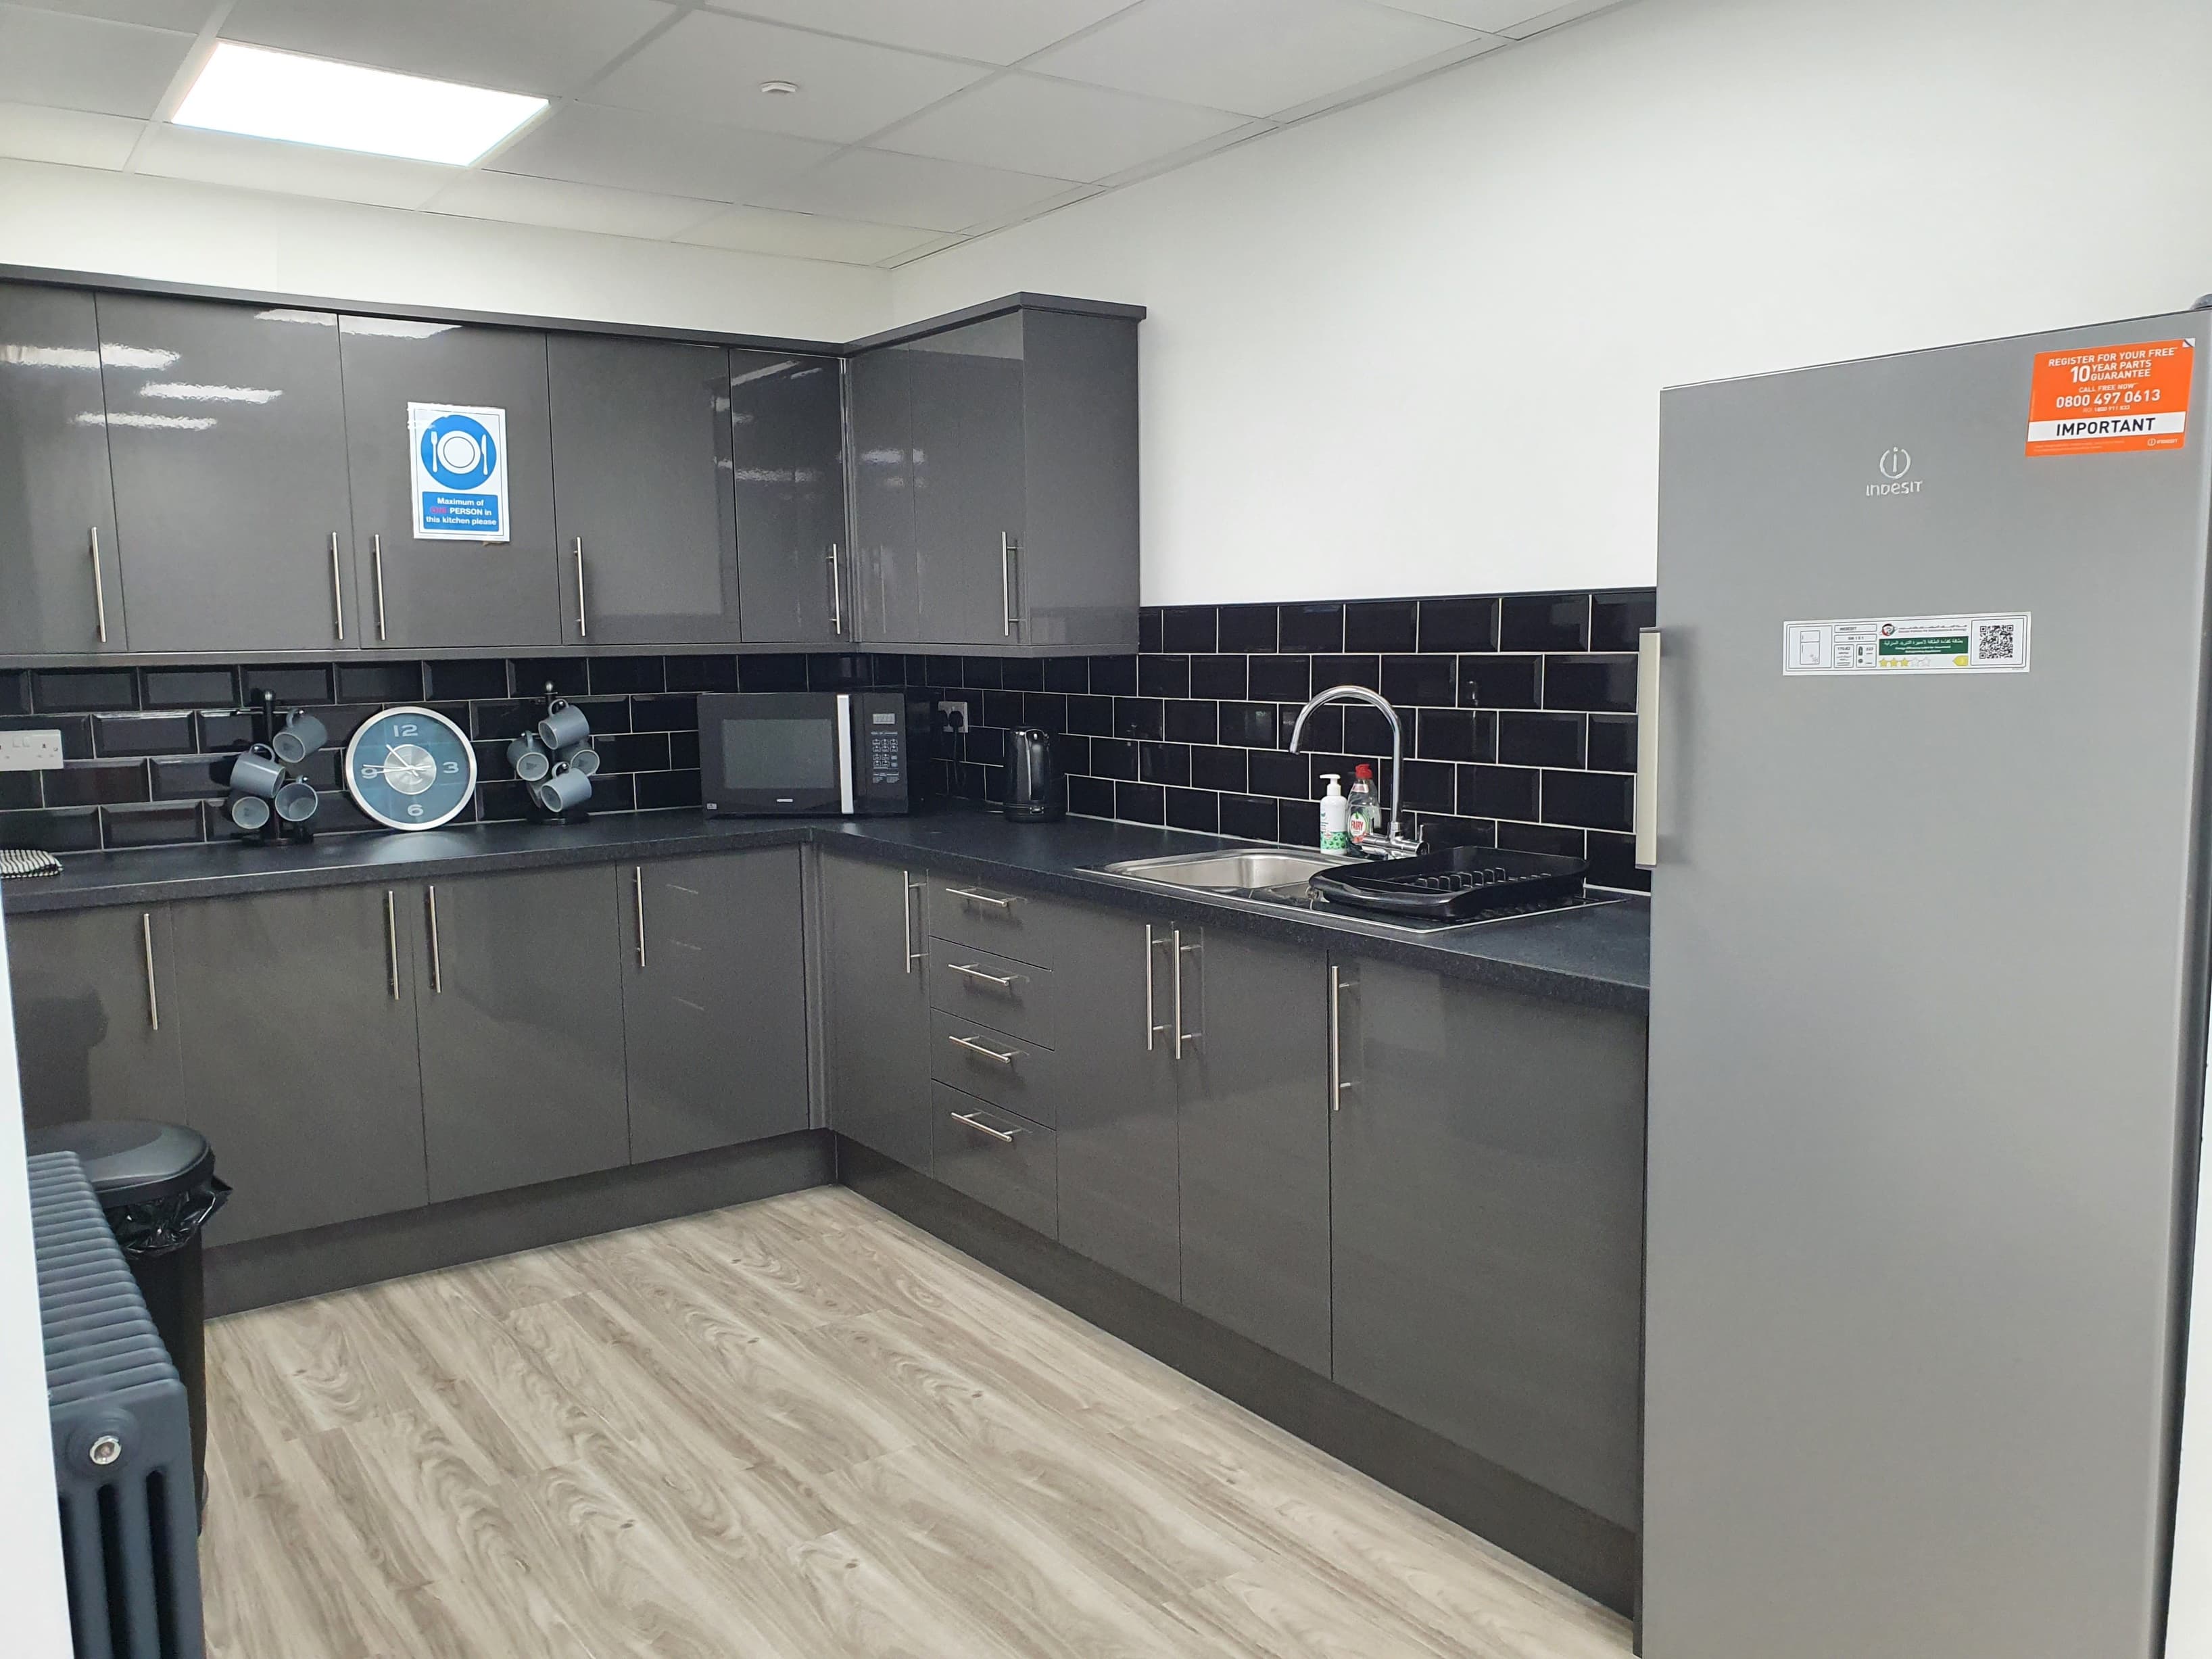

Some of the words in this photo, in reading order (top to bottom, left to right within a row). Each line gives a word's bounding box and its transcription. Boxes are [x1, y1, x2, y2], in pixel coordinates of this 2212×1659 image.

[2048, 355, 2095, 366] REGISTER
[2097, 353, 2117, 362] FOR
[2120, 350, 2146, 360] YOUR
[2092, 362, 2117, 372] YEAR
[2119, 360, 2152, 370] PARTS
[2070, 365, 2090, 383] 10
[2091, 368, 2152, 381] GUARANTEE
[2056, 394, 2090, 408] 0800
[2094, 391, 2121, 406] 497
[2124, 389, 2161, 404] 0613
[2057, 417, 2156, 437] IMPORTANT
[437, 497, 475, 506] Maximum
[450, 507, 483, 515] PERSON
[442, 516, 471, 524] kitchen
[471, 518, 497, 526] please
[393, 724, 418, 738] 12
[361, 767, 378, 779] 9
[442, 761, 459, 774] 3
[407, 804, 424, 817] 6
[1351, 820, 1364, 831] FAIRY
